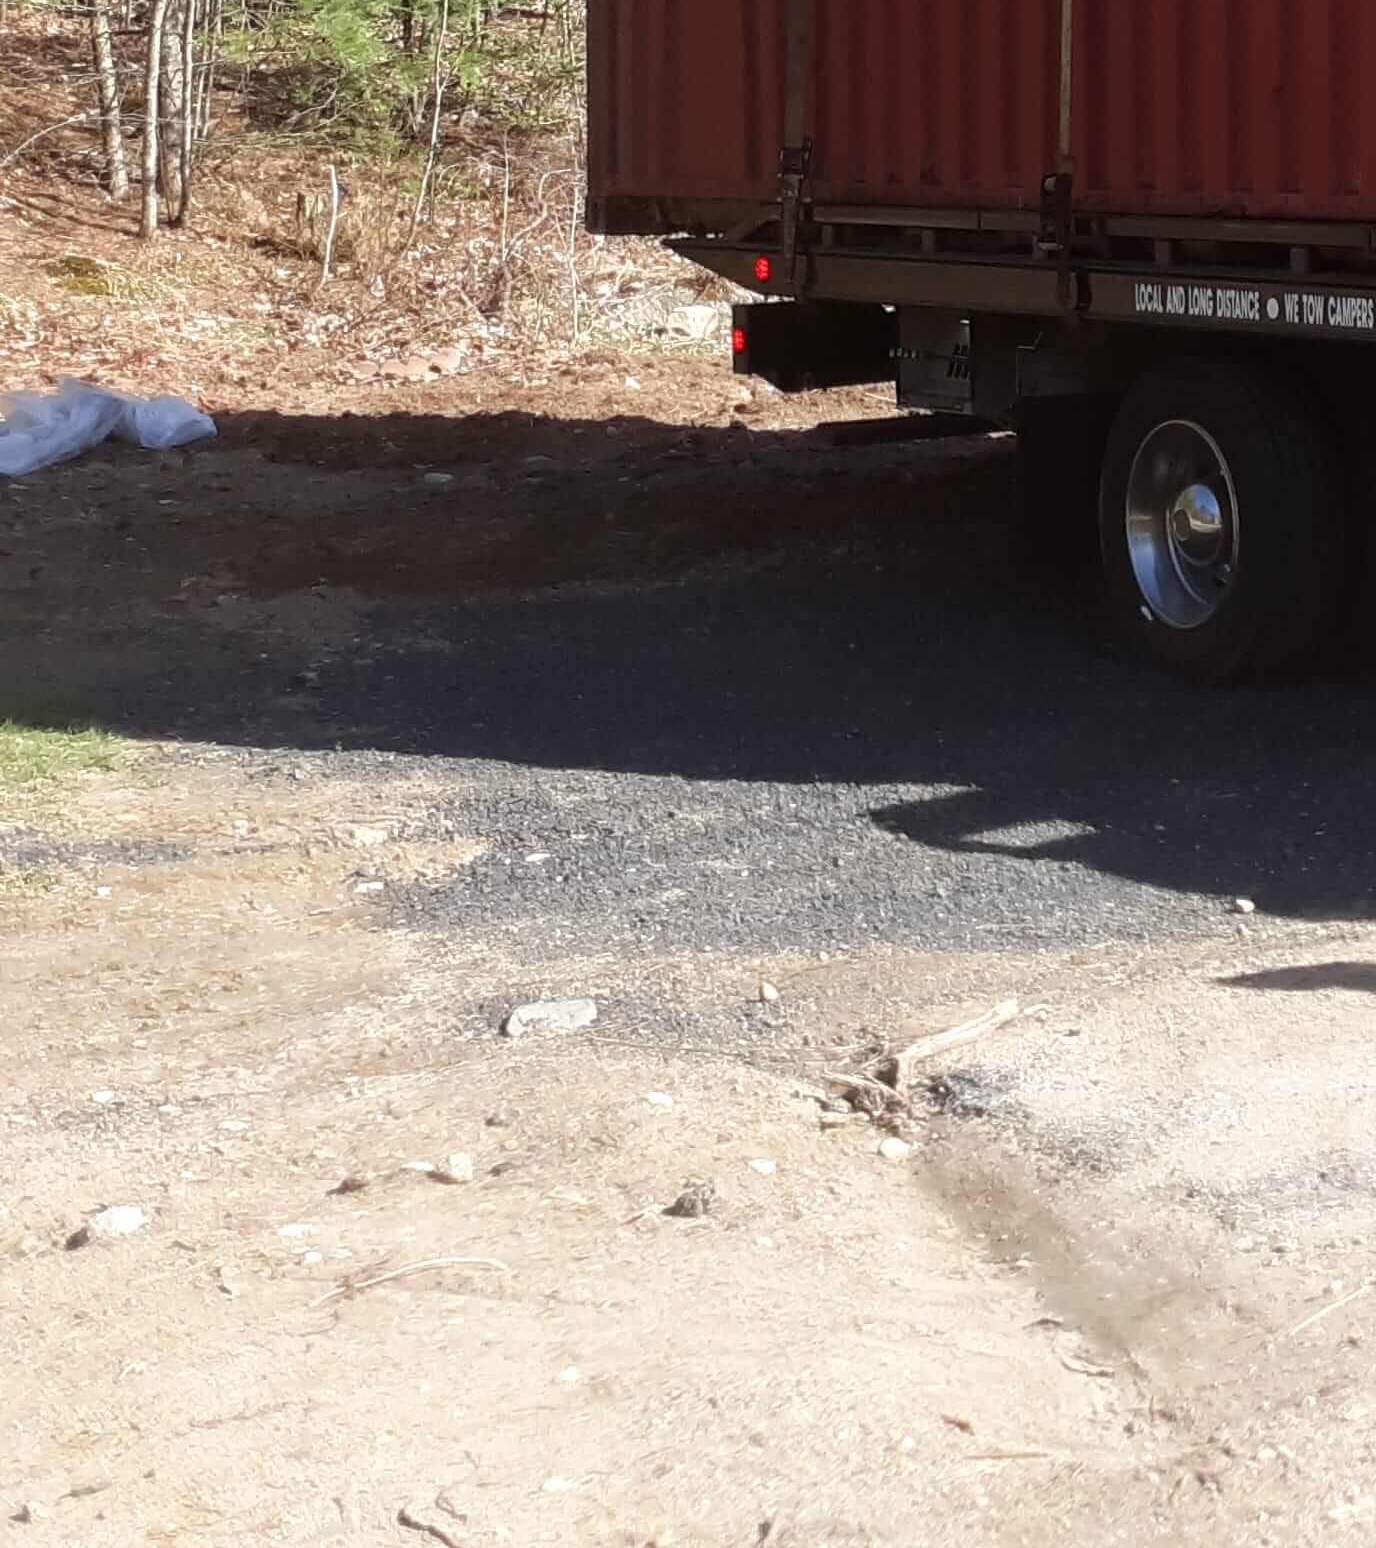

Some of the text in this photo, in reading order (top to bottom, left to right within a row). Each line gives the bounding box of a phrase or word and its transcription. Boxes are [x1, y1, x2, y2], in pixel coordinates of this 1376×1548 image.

[1135, 284, 1163, 311] LOCAL
[1166, 286, 1185, 313] AND
[1188, 287, 1213, 316] LONG
[1217, 289, 1260, 320] DISTANCE
[1284, 293, 1299, 322] WE
[1303, 295, 1324, 324] TOW
[1328, 298, 1374, 329] CAMPERS
